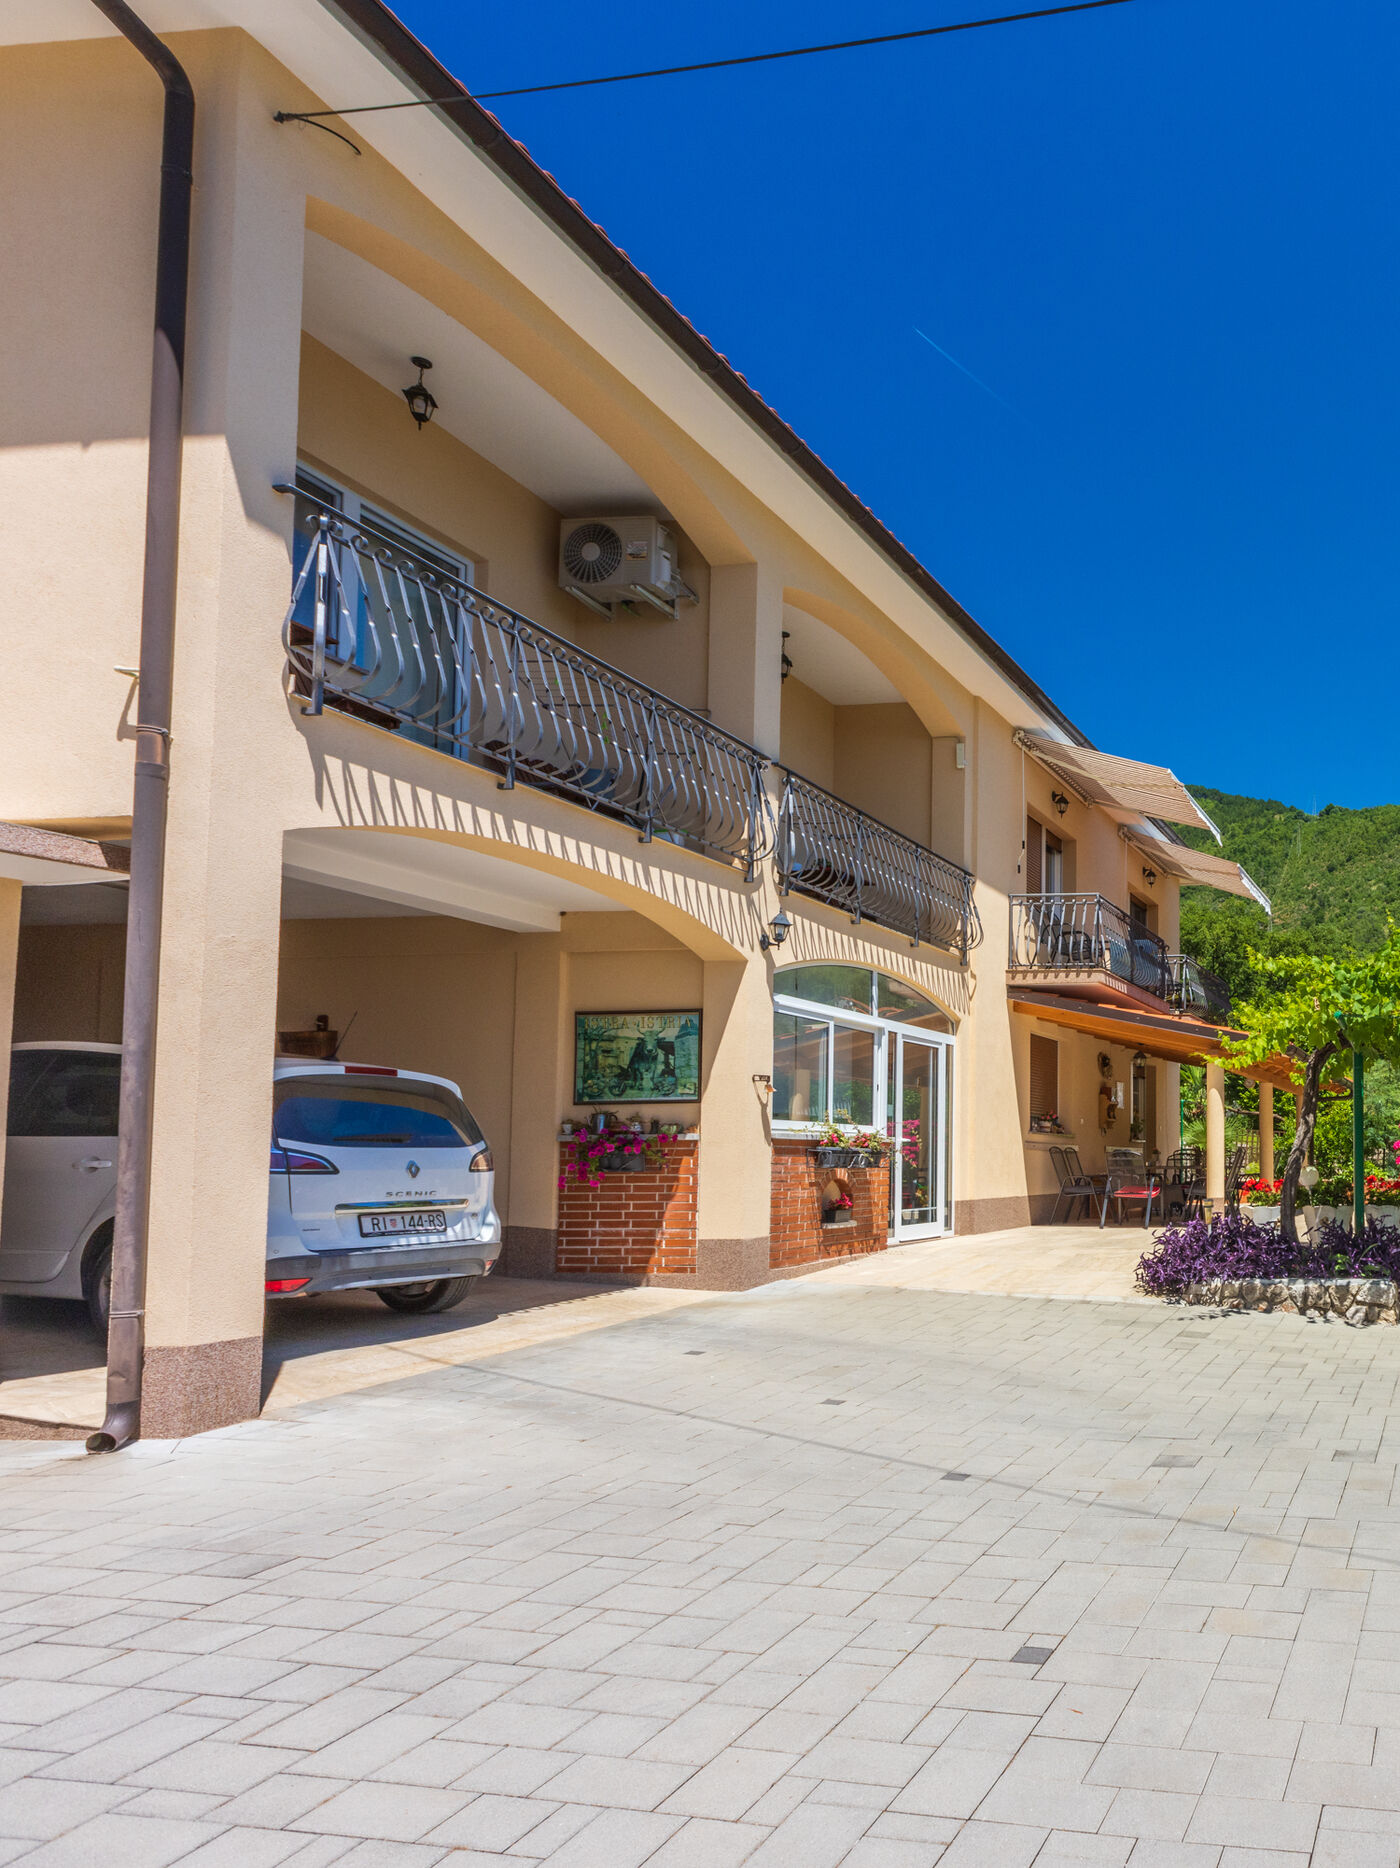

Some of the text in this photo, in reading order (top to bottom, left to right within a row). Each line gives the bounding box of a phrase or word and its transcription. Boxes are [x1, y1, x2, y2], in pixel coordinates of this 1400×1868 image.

[584, 1015, 692, 1029] ISTRA ISTRIA
[385, 1190, 438, 1198] SCENIC
[371, 1213, 444, 1231] RI 144-RS
